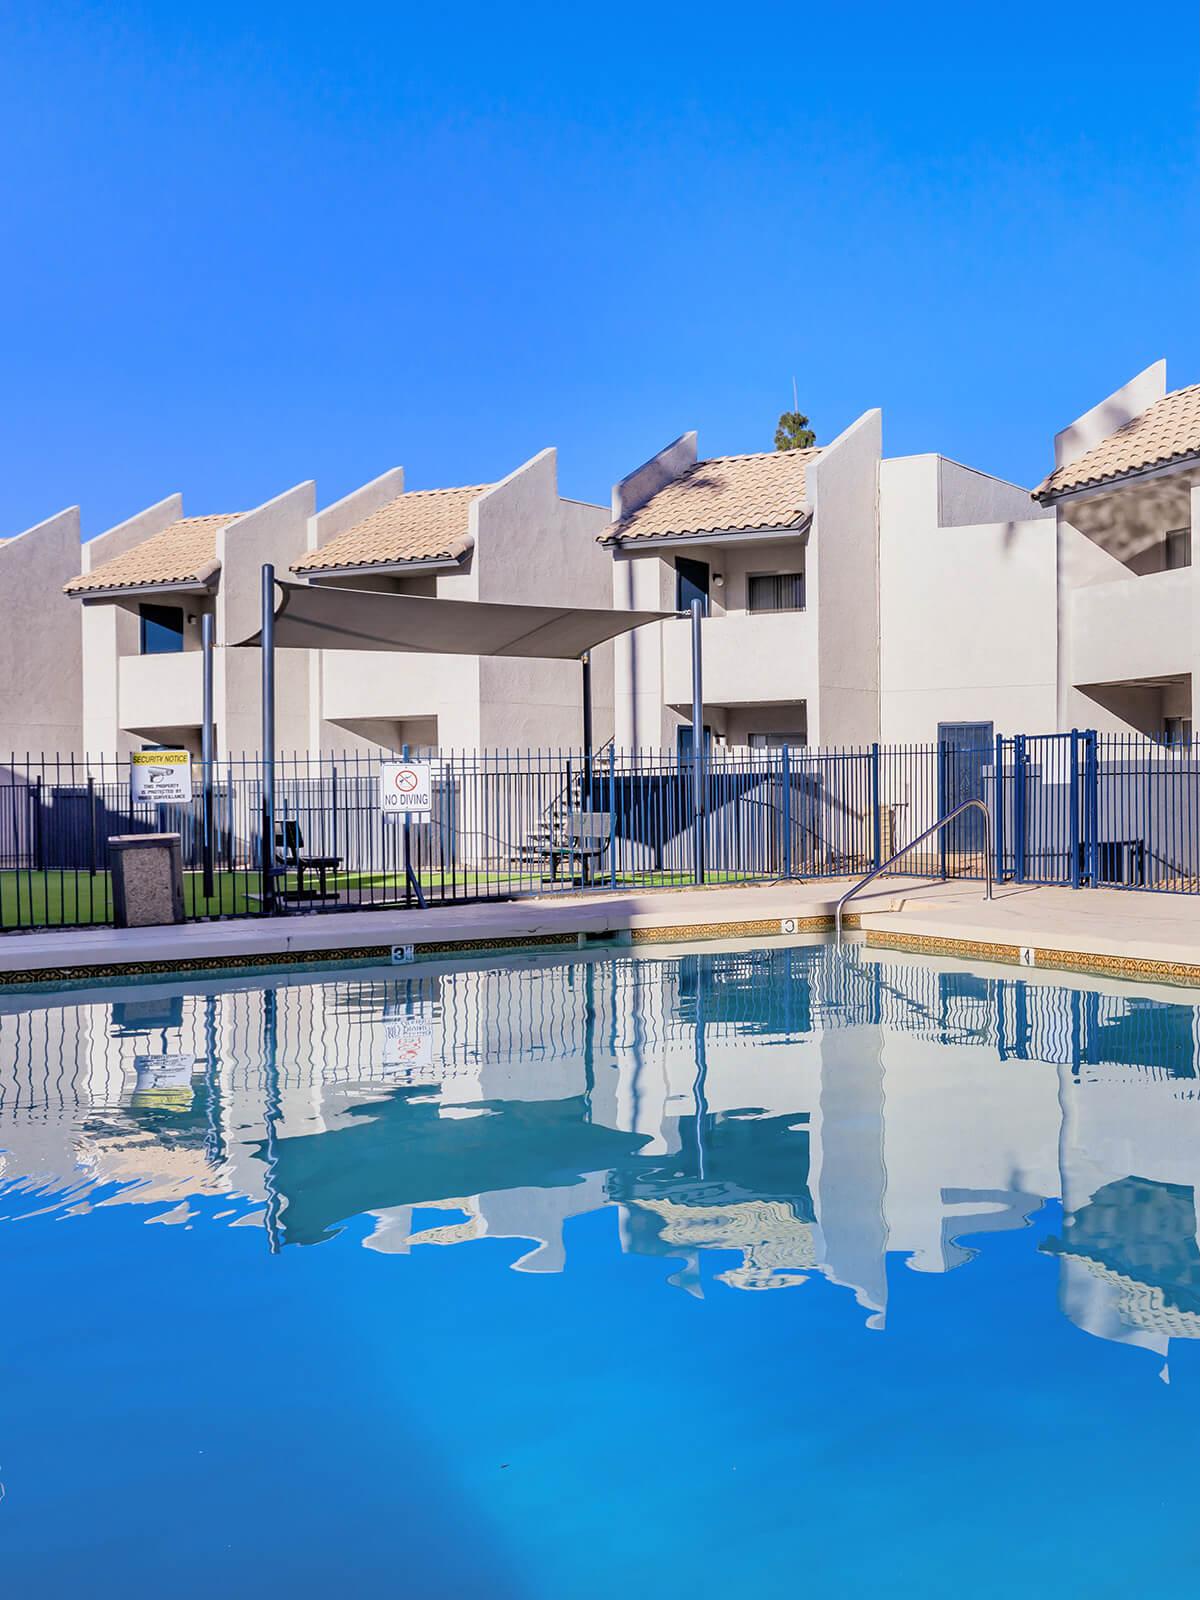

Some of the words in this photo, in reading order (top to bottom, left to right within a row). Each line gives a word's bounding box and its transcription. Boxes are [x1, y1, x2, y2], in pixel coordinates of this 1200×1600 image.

[133, 755, 163, 763] SECURITY
[164, 755, 188, 763] NOTICE
[385, 794, 397, 805] NO
[400, 793, 428, 805] DIVING
